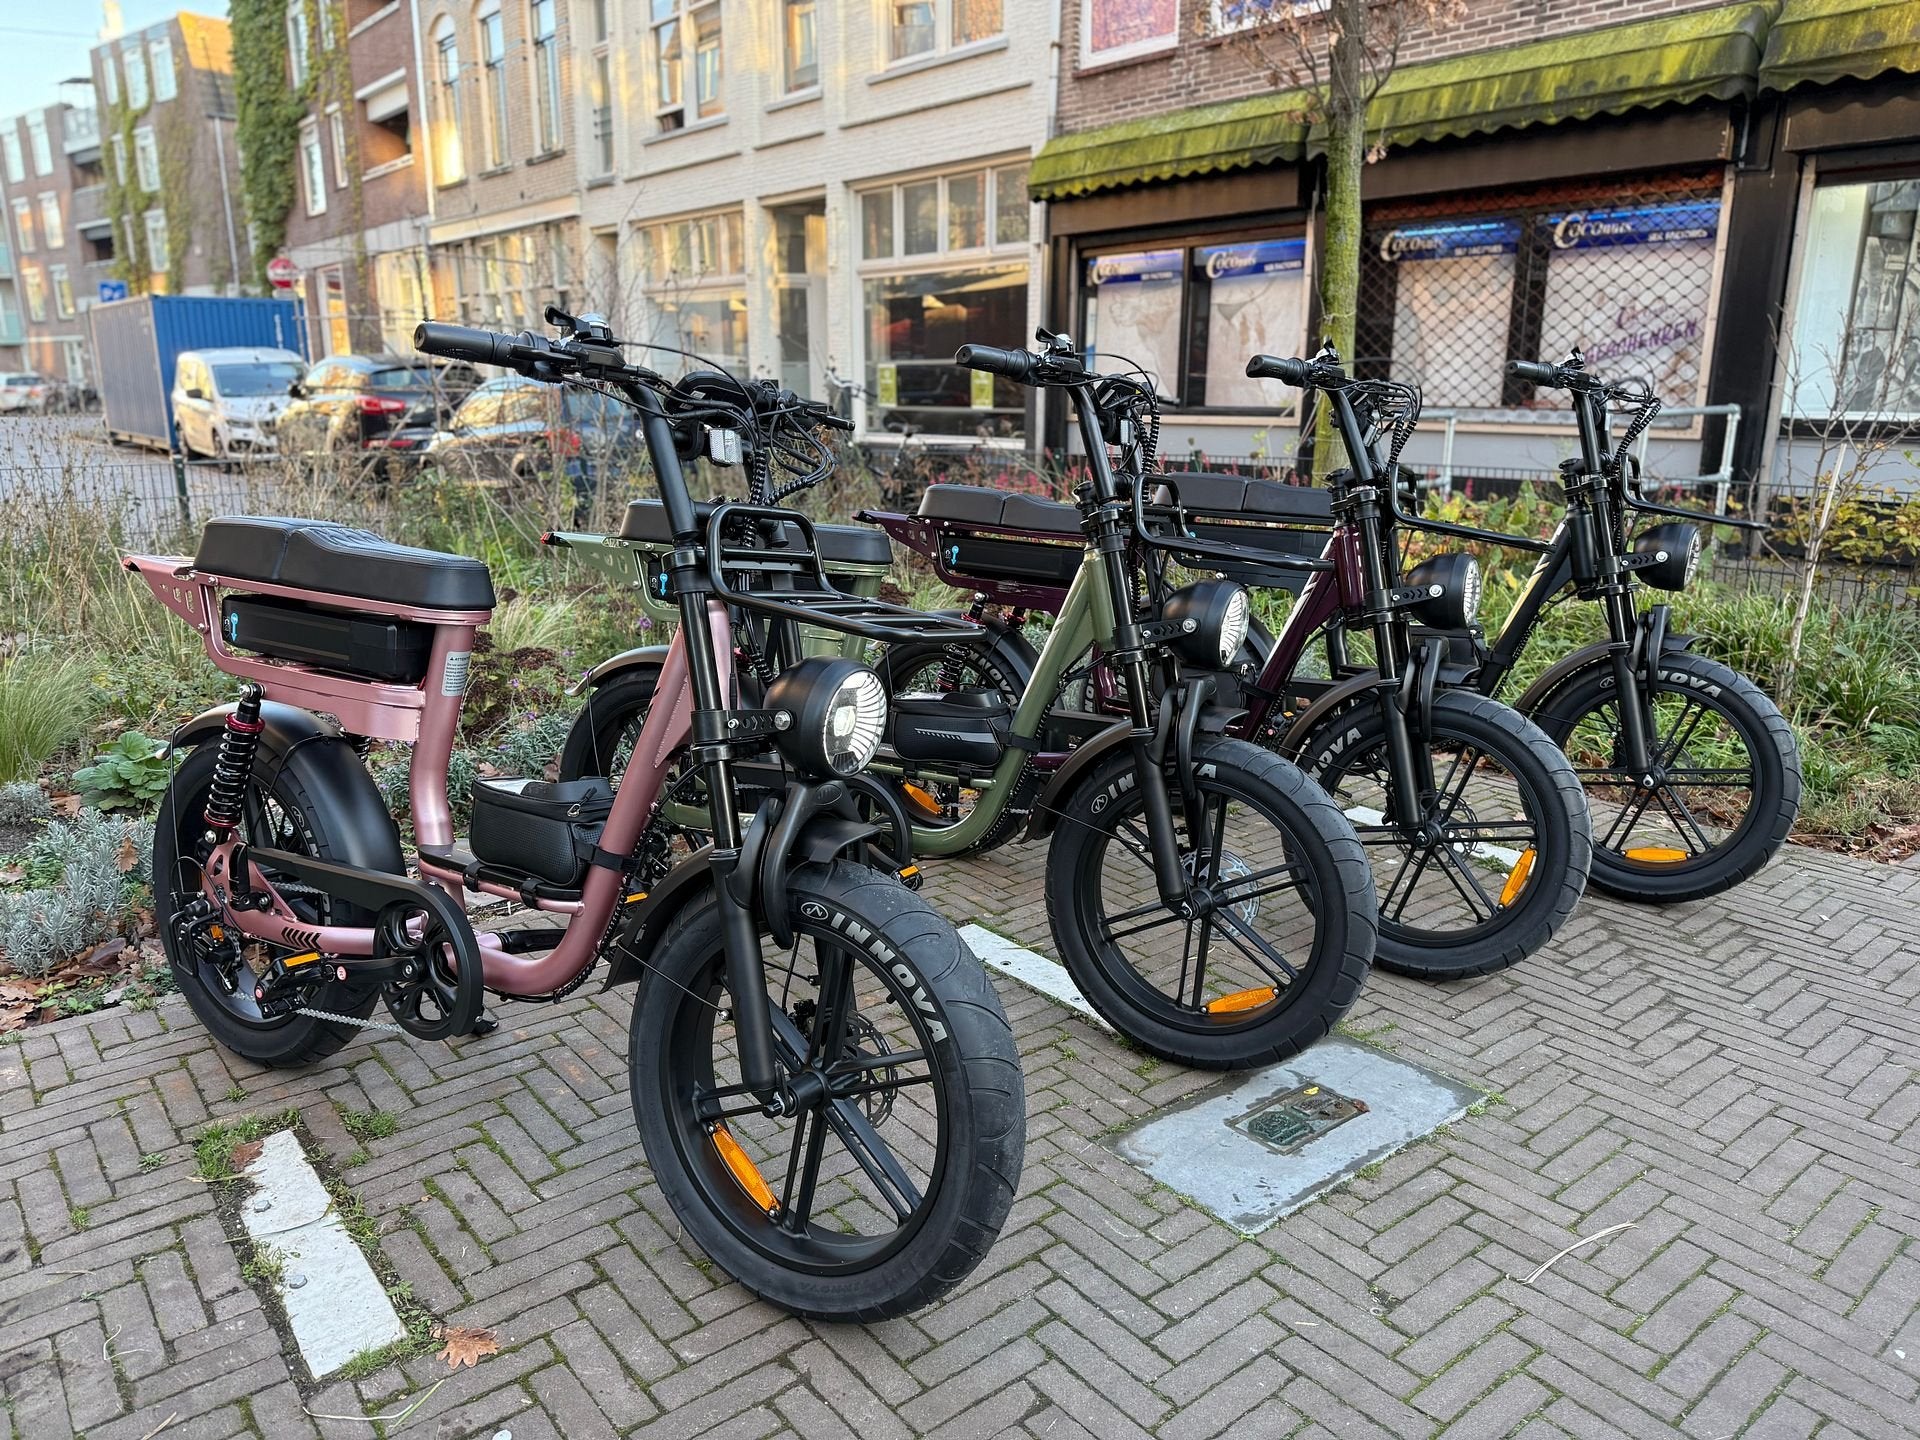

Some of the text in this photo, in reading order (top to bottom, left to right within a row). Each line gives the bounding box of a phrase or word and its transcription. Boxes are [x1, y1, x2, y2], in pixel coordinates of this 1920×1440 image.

[968, 649, 1018, 706] NNOVA
[1636, 670, 1722, 698] NNOVA
[831, 912, 948, 1043] INNOVA
